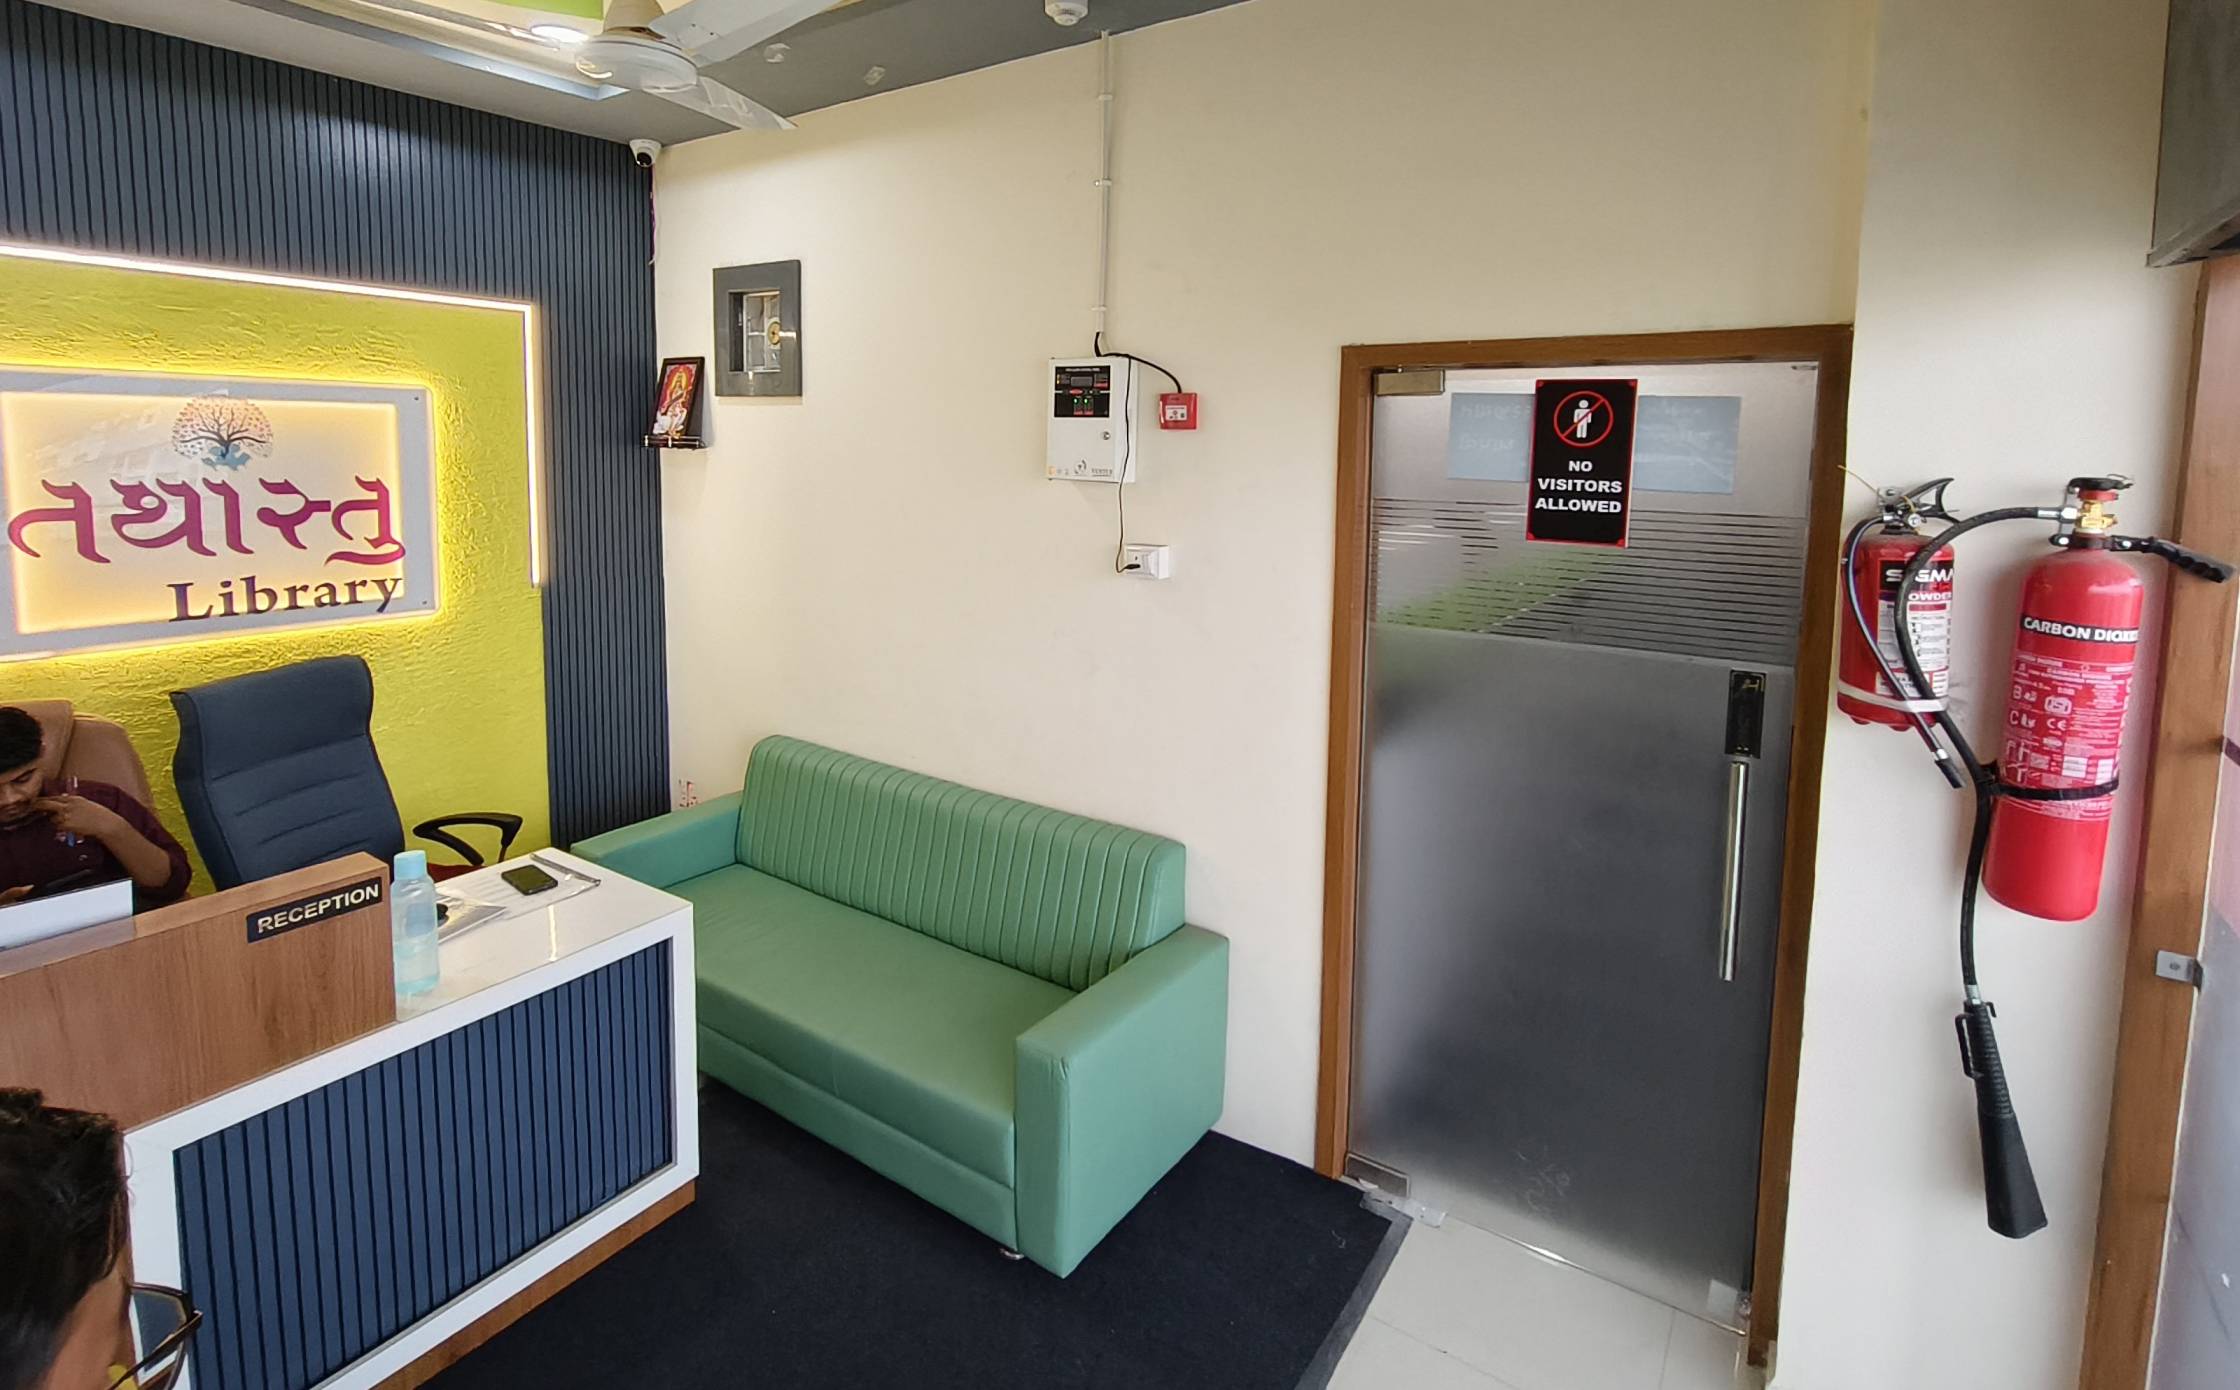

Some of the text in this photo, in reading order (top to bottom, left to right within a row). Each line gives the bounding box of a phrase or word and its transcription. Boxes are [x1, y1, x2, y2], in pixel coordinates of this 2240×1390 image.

[1568, 460, 1593, 472] NO
[1538, 478, 1623, 493] VISITORS
[1535, 498, 1622, 514] ALLOWED
[8, 475, 406, 564] તથાસ્તુ
[167, 576, 402, 622] Library
[2023, 617, 2091, 640] CARBON
[257, 883, 380, 934] RECEPTION
